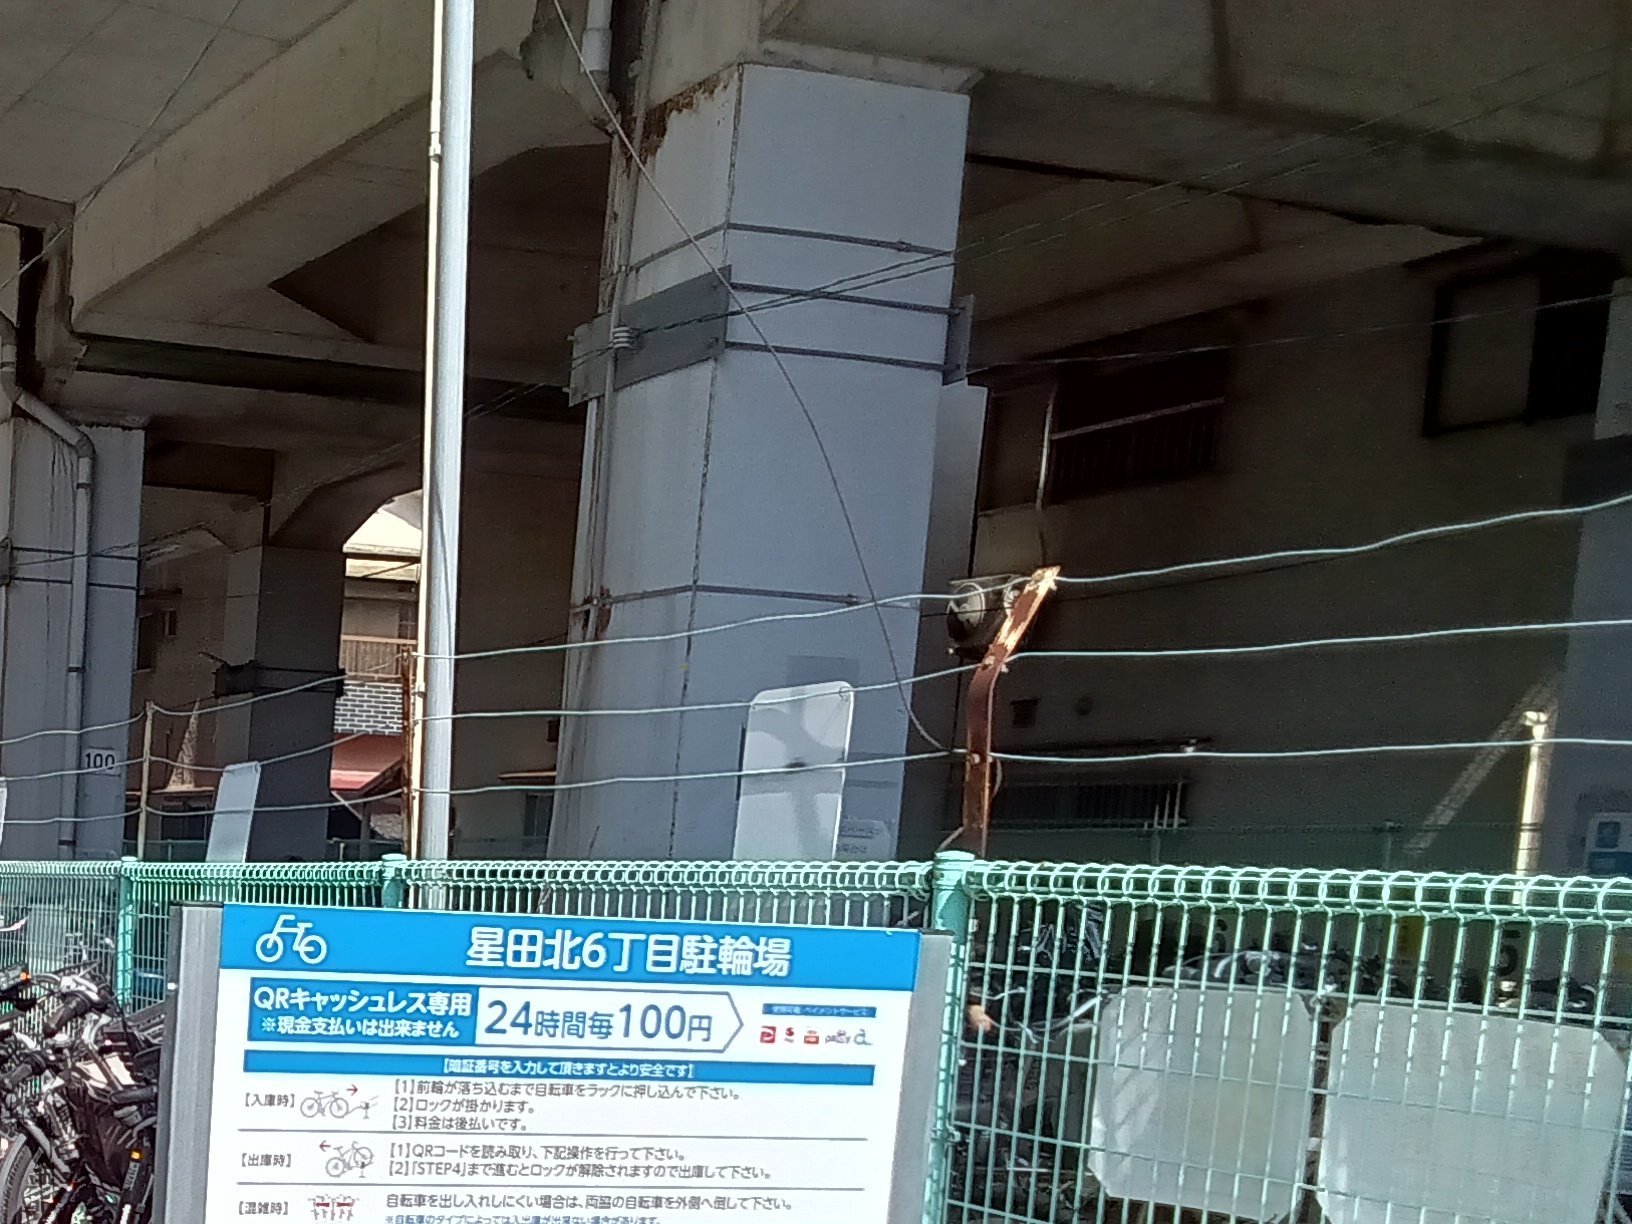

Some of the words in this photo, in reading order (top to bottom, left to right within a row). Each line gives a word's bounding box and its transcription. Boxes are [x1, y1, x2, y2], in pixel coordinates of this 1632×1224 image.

[85, 753, 115, 770] 100
[466, 926, 792, 977] 星田北6丁目駐輪場
[254, 986, 472, 1016] QRキャッシュレス専用
[261, 1016, 459, 1038] ※現金支払いは出来ません
[484, 1000, 712, 1042] 24時間毎100円
